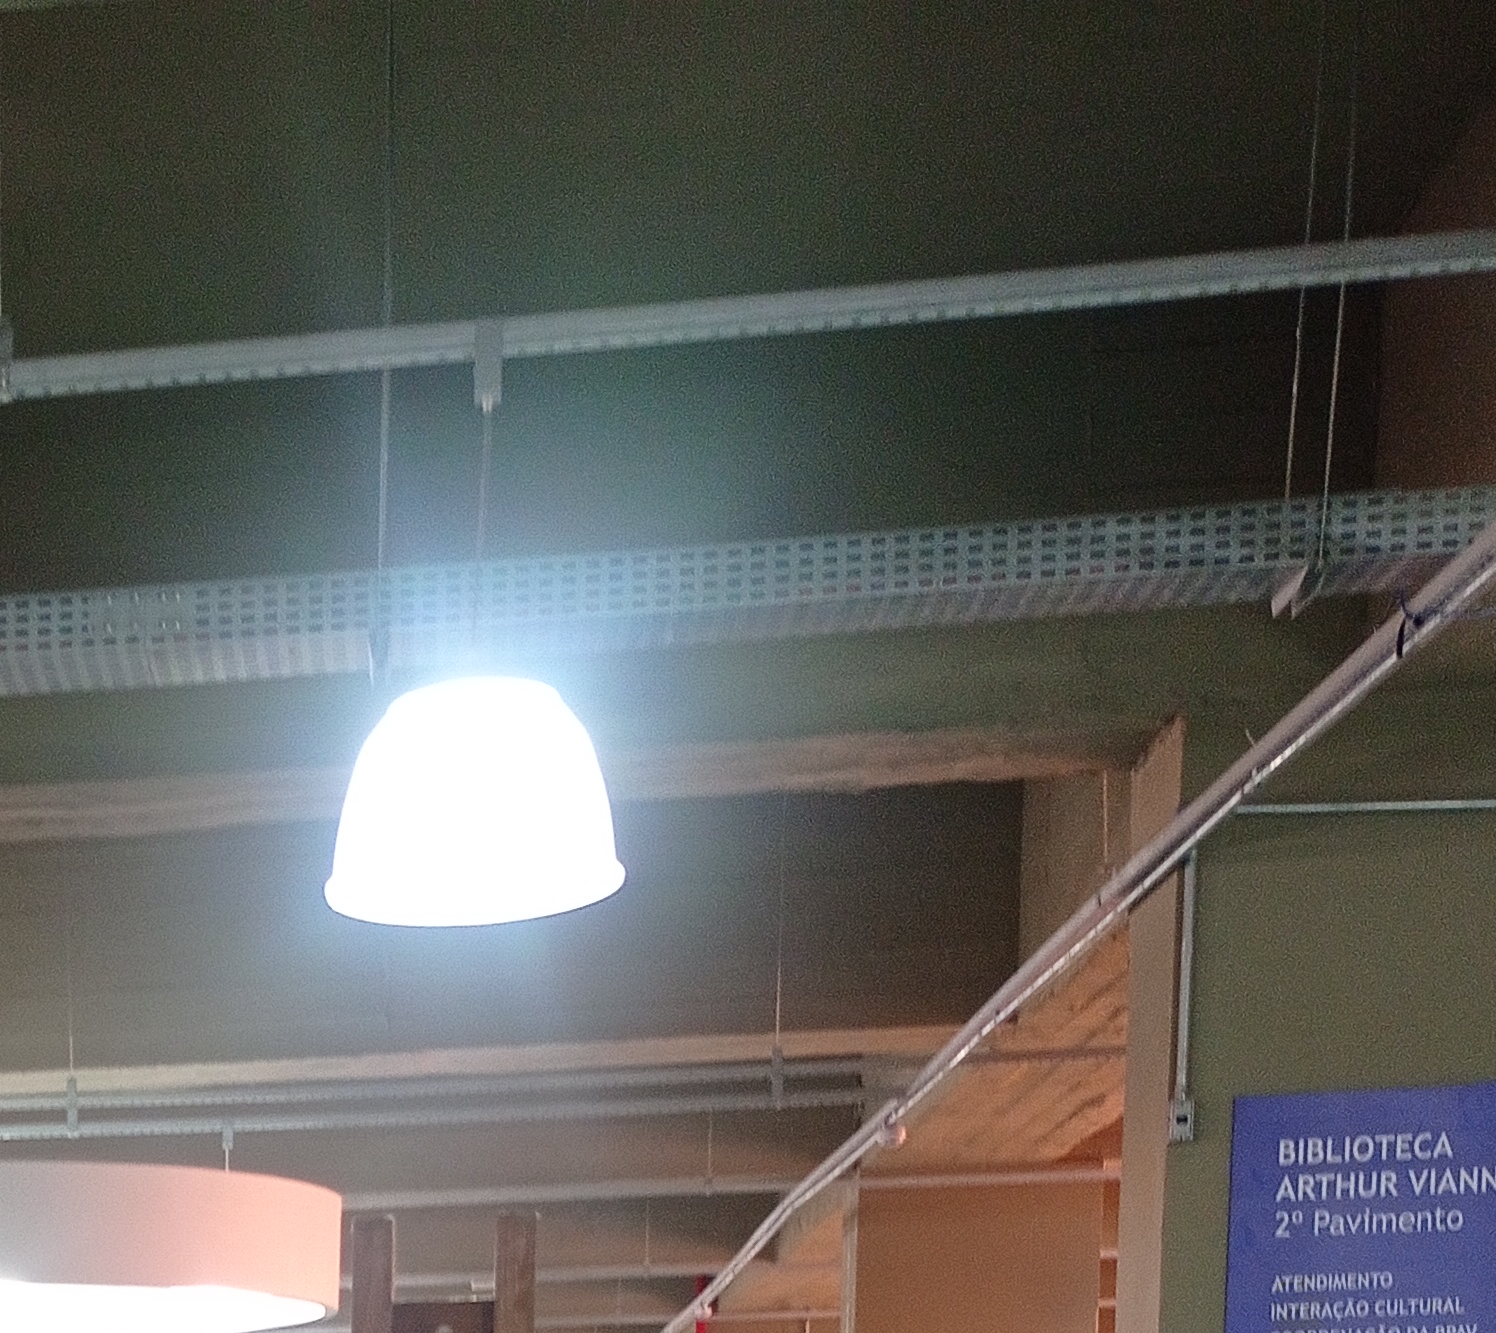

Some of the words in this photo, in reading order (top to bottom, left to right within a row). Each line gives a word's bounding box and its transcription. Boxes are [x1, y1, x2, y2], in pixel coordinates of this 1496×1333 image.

[1279, 1131, 1453, 1166] BIBLIOTECA
[1276, 1170, 1398, 1202] ARTHUR
[1408, 1166, 1496, 1196] VIANN
[1275, 1210, 1303, 1238] 2º
[1314, 1206, 1464, 1237] Pavimento
[1271, 1272, 1393, 1293] ATENDIMENTO
[1270, 1297, 1369, 1321] INTERAÇÃO
[1375, 1296, 1465, 1317] CULTURAL
